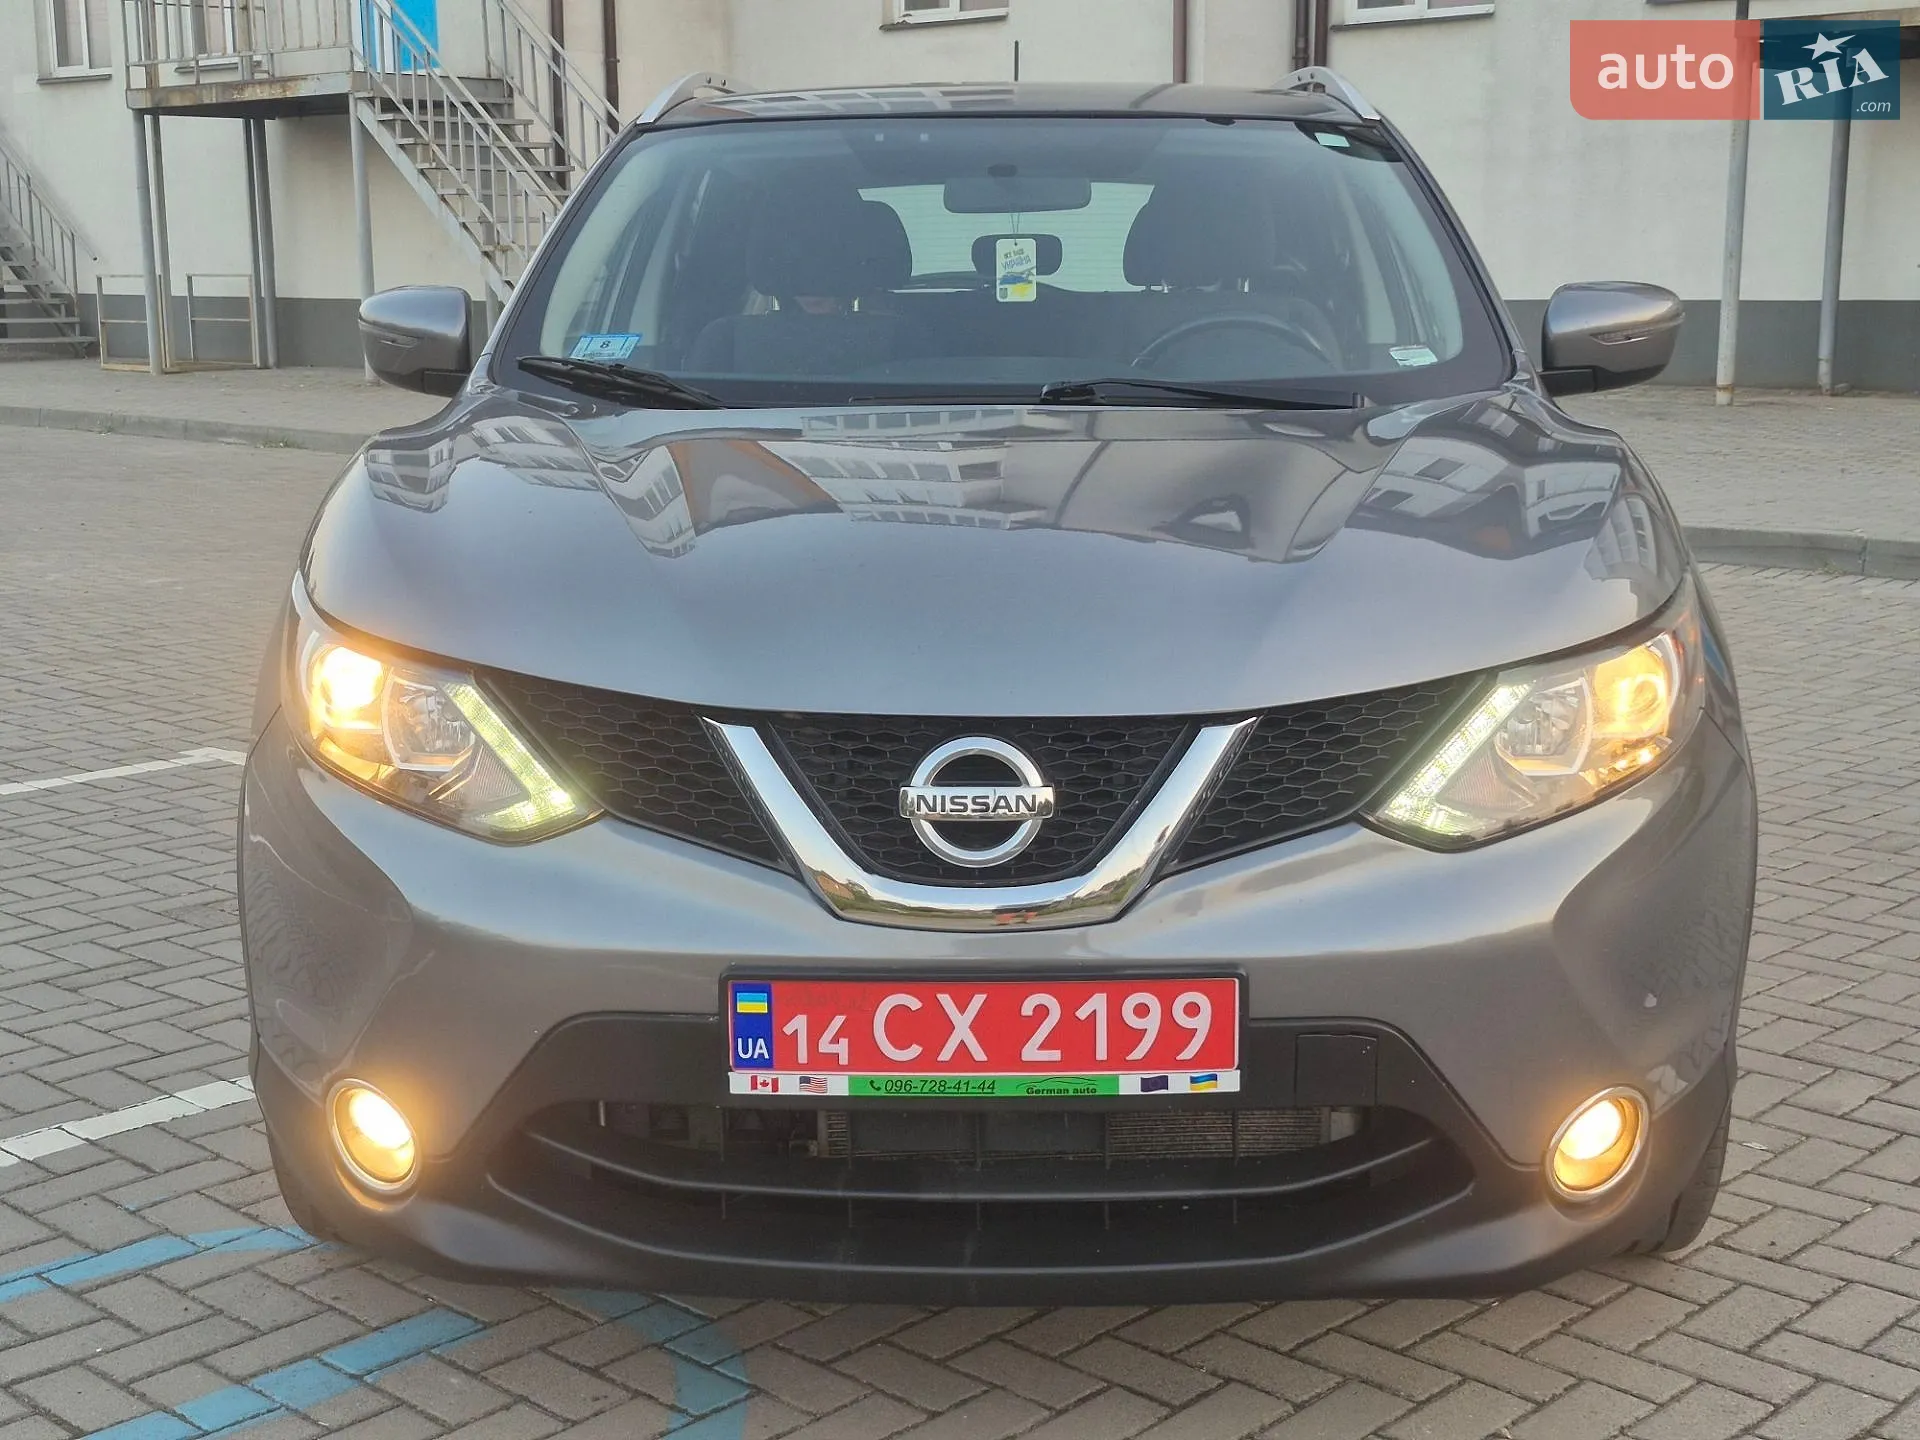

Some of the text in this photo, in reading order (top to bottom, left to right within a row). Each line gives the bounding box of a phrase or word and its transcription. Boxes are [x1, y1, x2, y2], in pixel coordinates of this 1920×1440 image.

[915, 794, 1037, 813] NISSAN
[782, 991, 1212, 1065] 14 CX 2199
[737, 1038, 769, 1059] UA
[884, 1079, 997, 1093] 096-728-41-44
[1025, 1086, 1097, 1096] German auto
